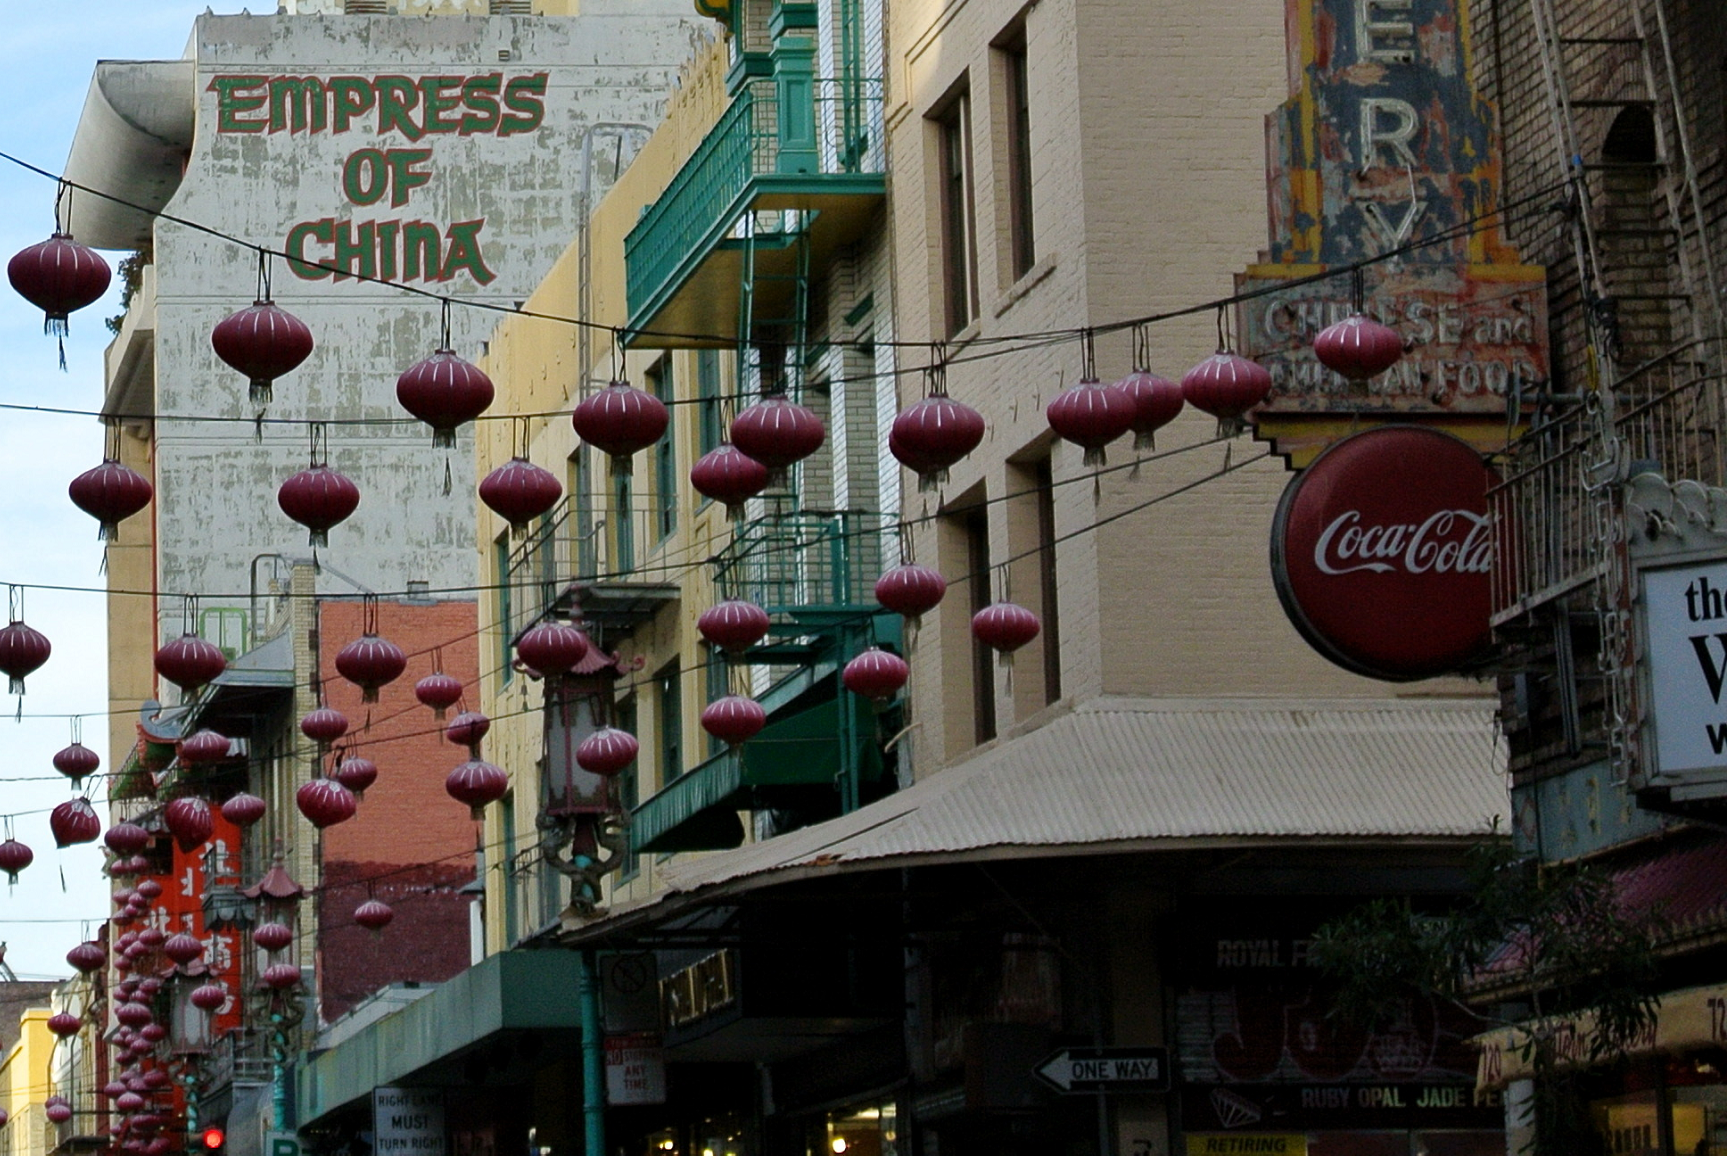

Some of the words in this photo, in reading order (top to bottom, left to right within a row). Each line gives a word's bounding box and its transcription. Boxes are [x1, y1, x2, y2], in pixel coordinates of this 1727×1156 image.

[206, 73, 549, 142] EMPRESS
[342, 148, 433, 209] OF
[285, 217, 497, 286] CHINA
[1314, 510, 1501, 575] Coca-Cola
[1684, 577, 1727, 623] th
[1073, 1062, 1109, 1080] ONE
[1115, 1061, 1152, 1079] WAY
[1301, 1086, 1351, 1109] RUBY
[1358, 1087, 1406, 1108] OPAL
[1416, 1087, 1466, 1108] JADE
[392, 1115, 428, 1129] MUST
[379, 1139, 407, 1150] TURN
[1206, 1138, 1286, 1152] RETIRING
